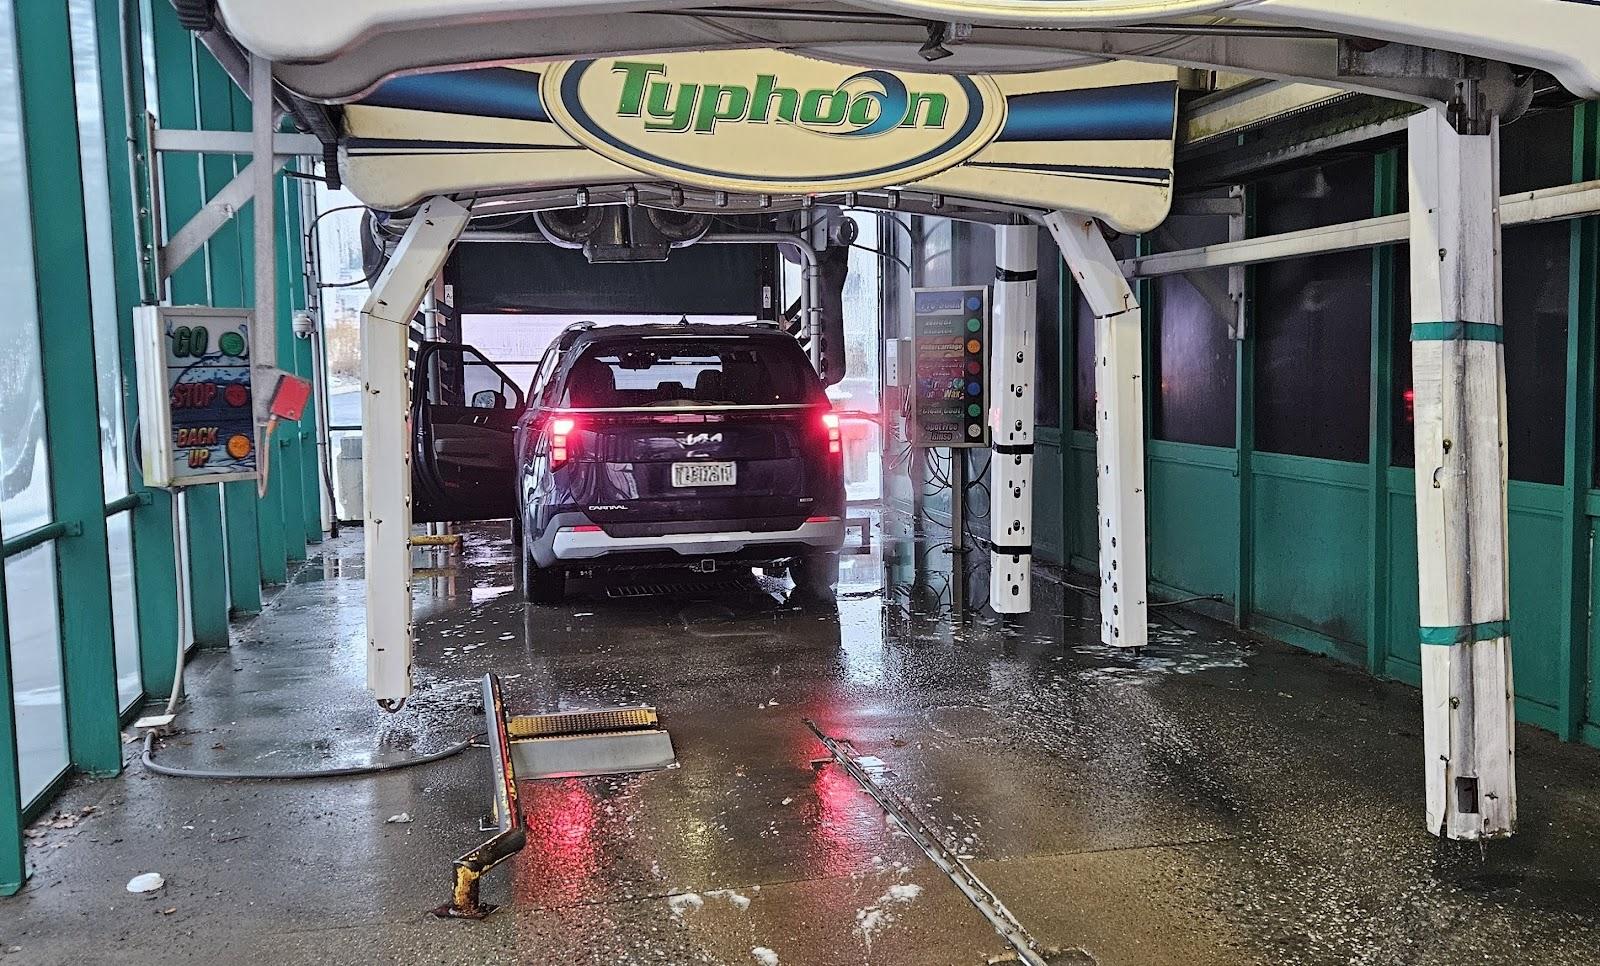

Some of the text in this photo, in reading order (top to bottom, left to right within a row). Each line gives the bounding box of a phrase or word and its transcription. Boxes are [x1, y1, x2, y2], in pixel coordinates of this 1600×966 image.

[611, 61, 949, 136] Typhoon
[172, 325, 209, 358] GO
[172, 382, 217, 409] STOP
[177, 427, 219, 448] BACK
[188, 448, 210, 469] UP
